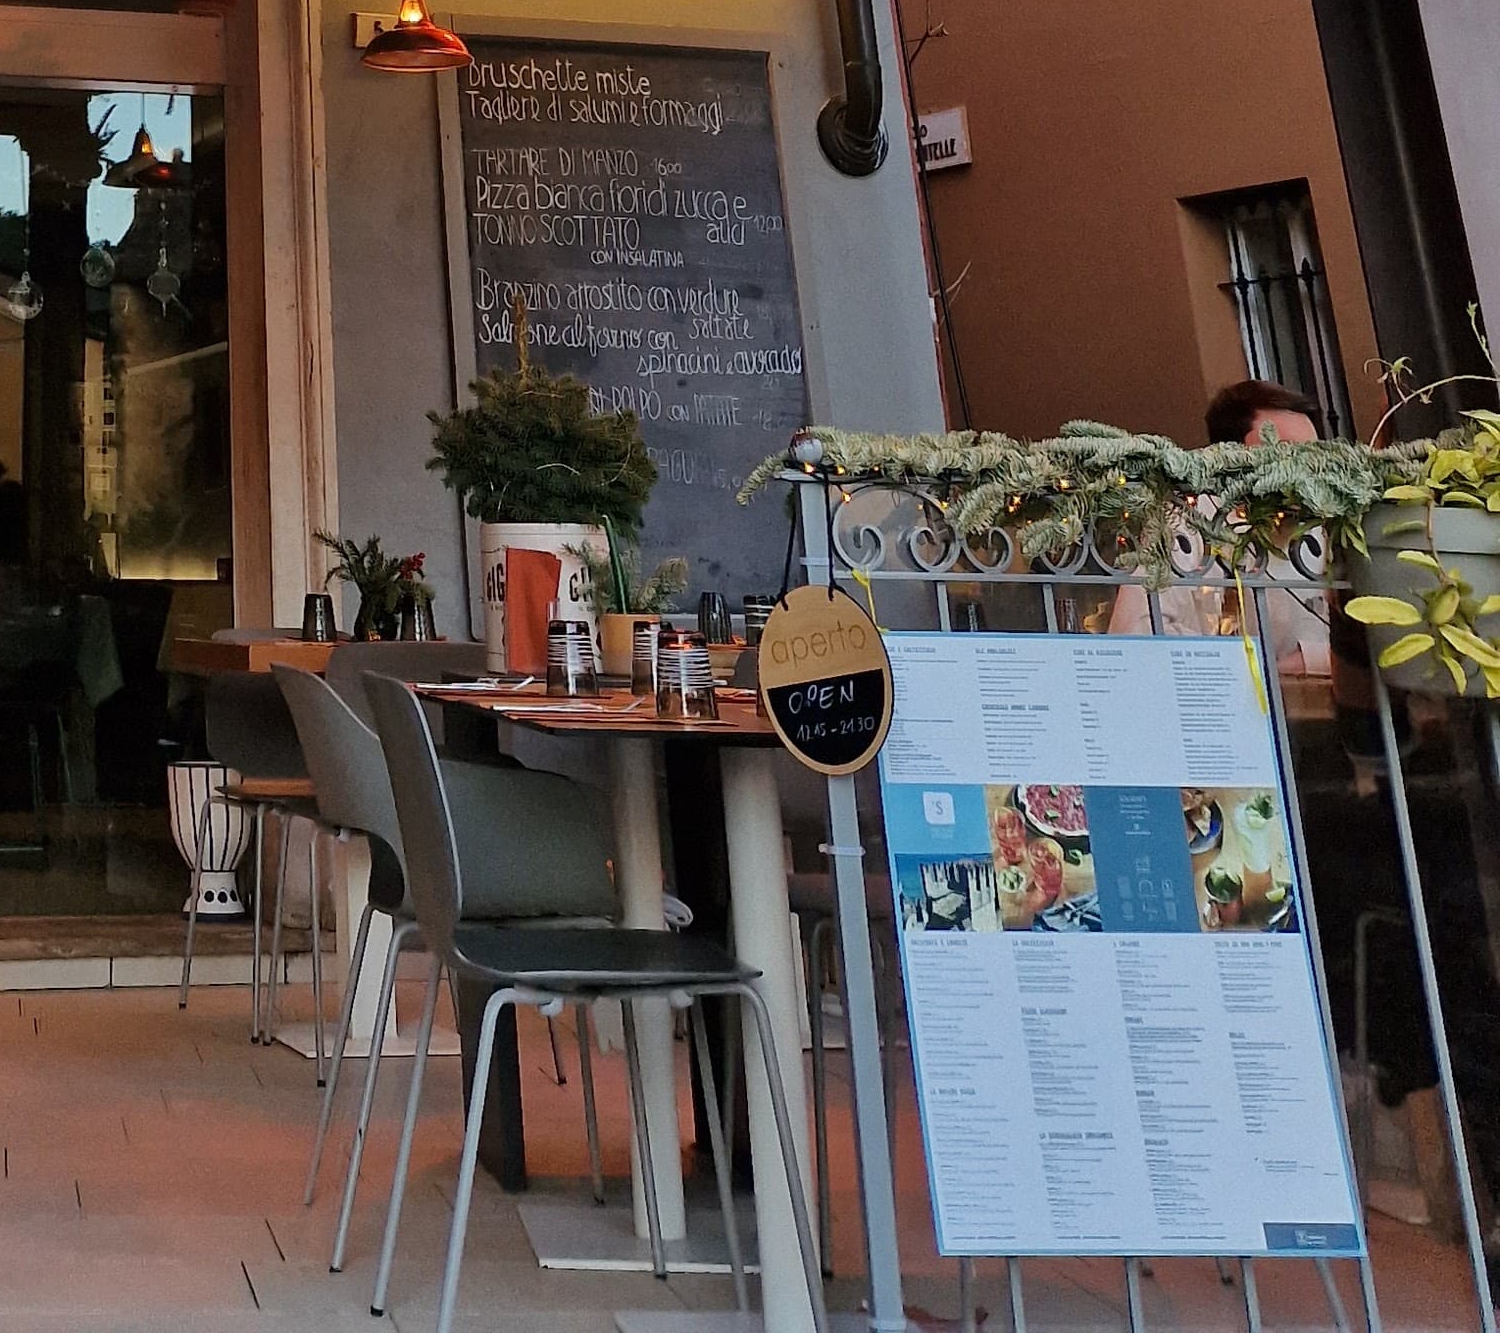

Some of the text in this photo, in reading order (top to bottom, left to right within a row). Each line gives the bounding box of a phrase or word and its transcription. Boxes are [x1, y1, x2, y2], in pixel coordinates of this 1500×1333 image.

[596, 64, 651, 95] miste
[465, 89, 541, 126] Tagliere
[546, 92, 563, 122] di
[569, 93, 626, 125] salumi
[471, 148, 550, 176] TARTARE
[559, 147, 576, 177] DI
[582, 148, 639, 177] MANZO
[475, 176, 530, 210] Pizza
[732, 195, 755, 221] e
[472, 212, 640, 251] TONNO SCOTTATO
[771, 620, 867, 668] aperto
[788, 679, 855, 714] OPEN
